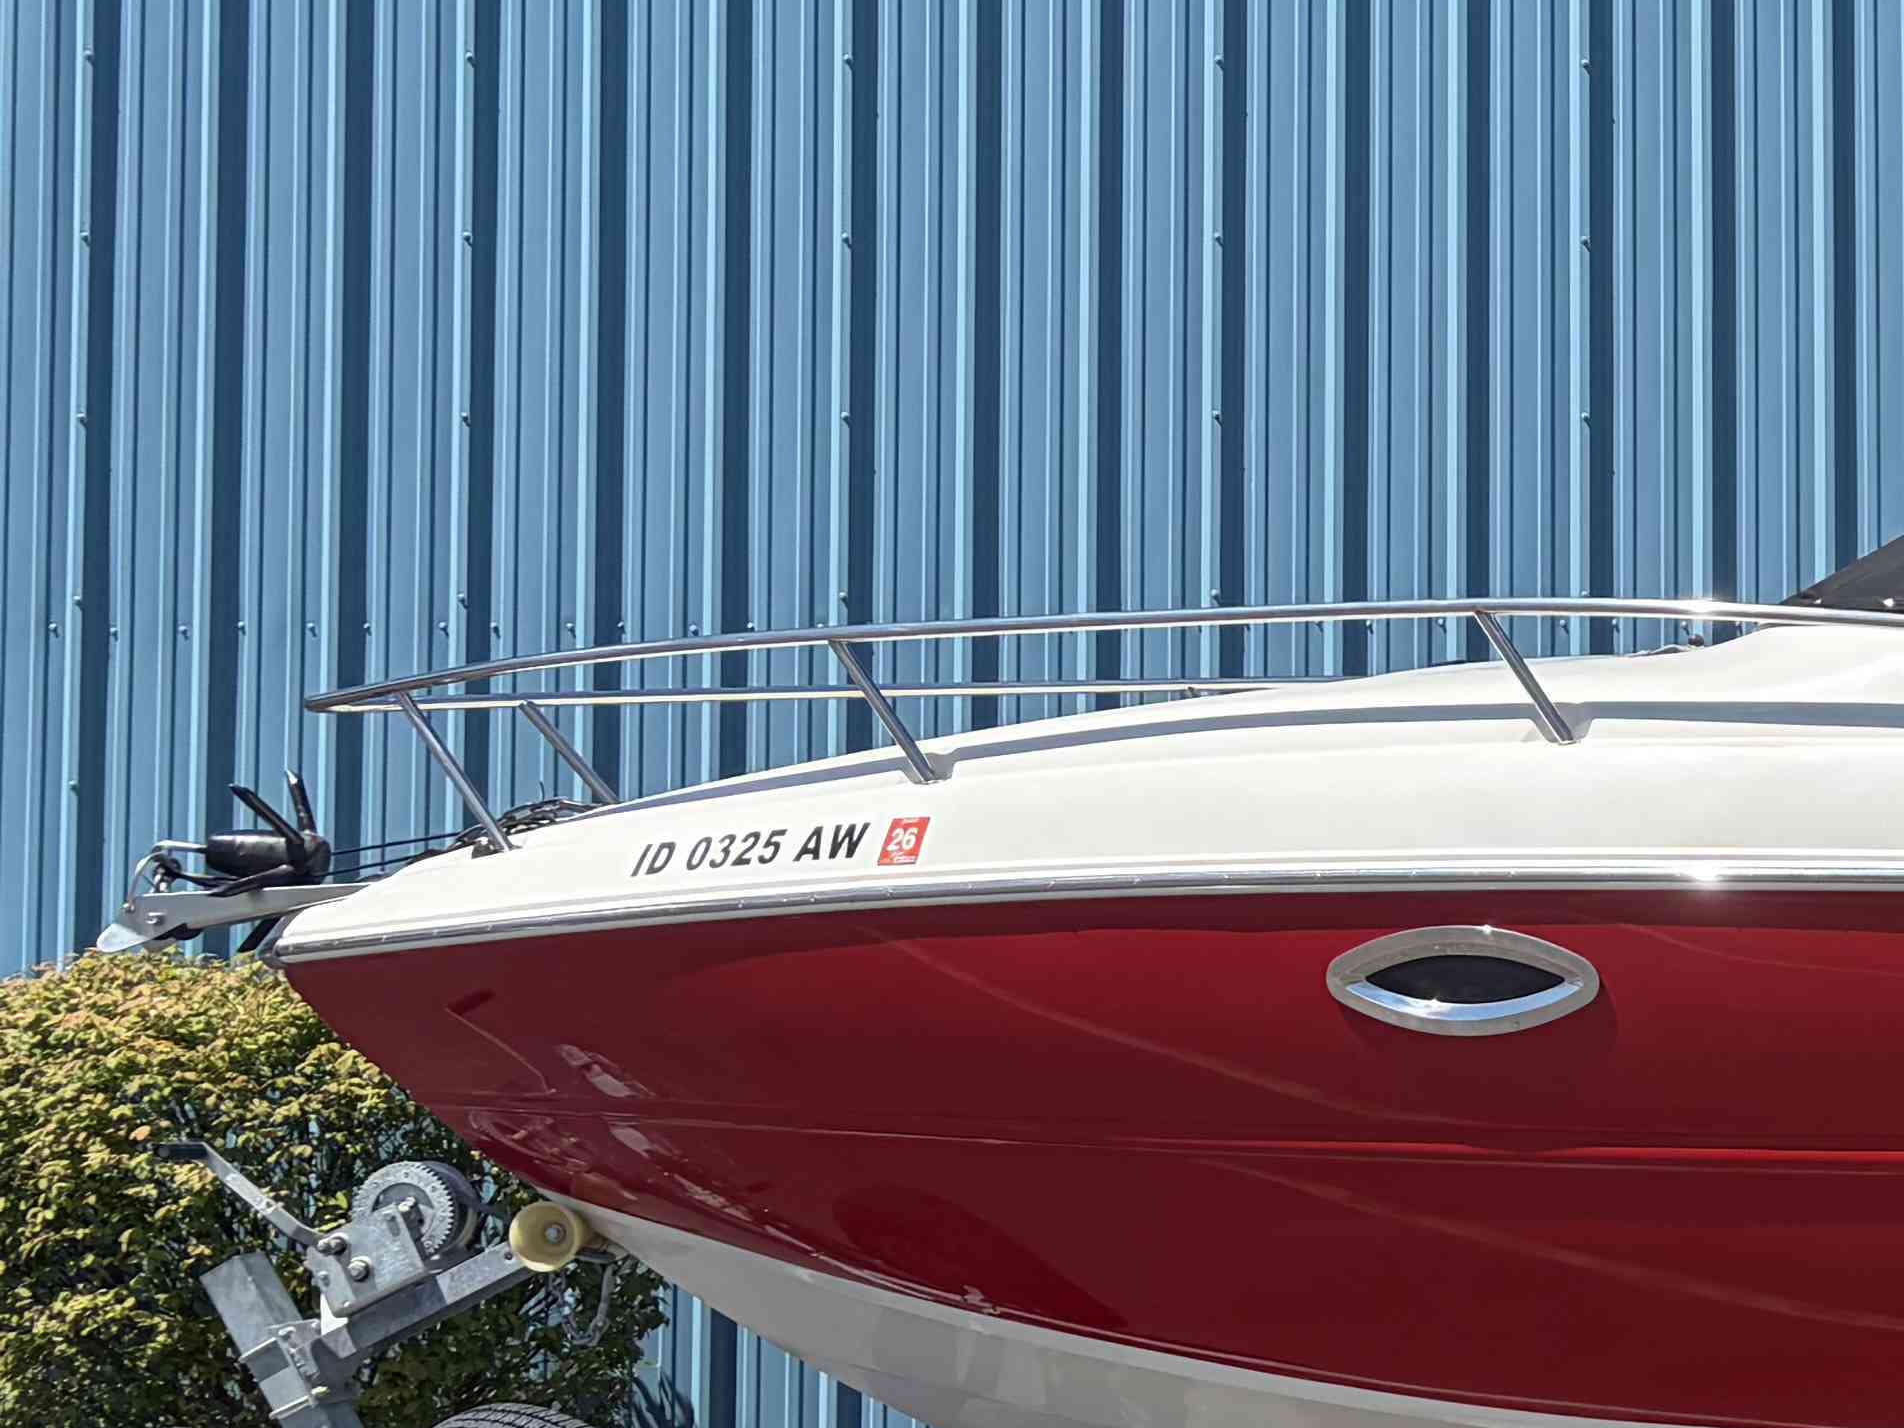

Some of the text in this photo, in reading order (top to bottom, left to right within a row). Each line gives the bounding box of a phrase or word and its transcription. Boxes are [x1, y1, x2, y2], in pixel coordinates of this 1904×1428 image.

[630, 822, 871, 877] ID 0325 AW
[886, 827, 919, 852] 26
